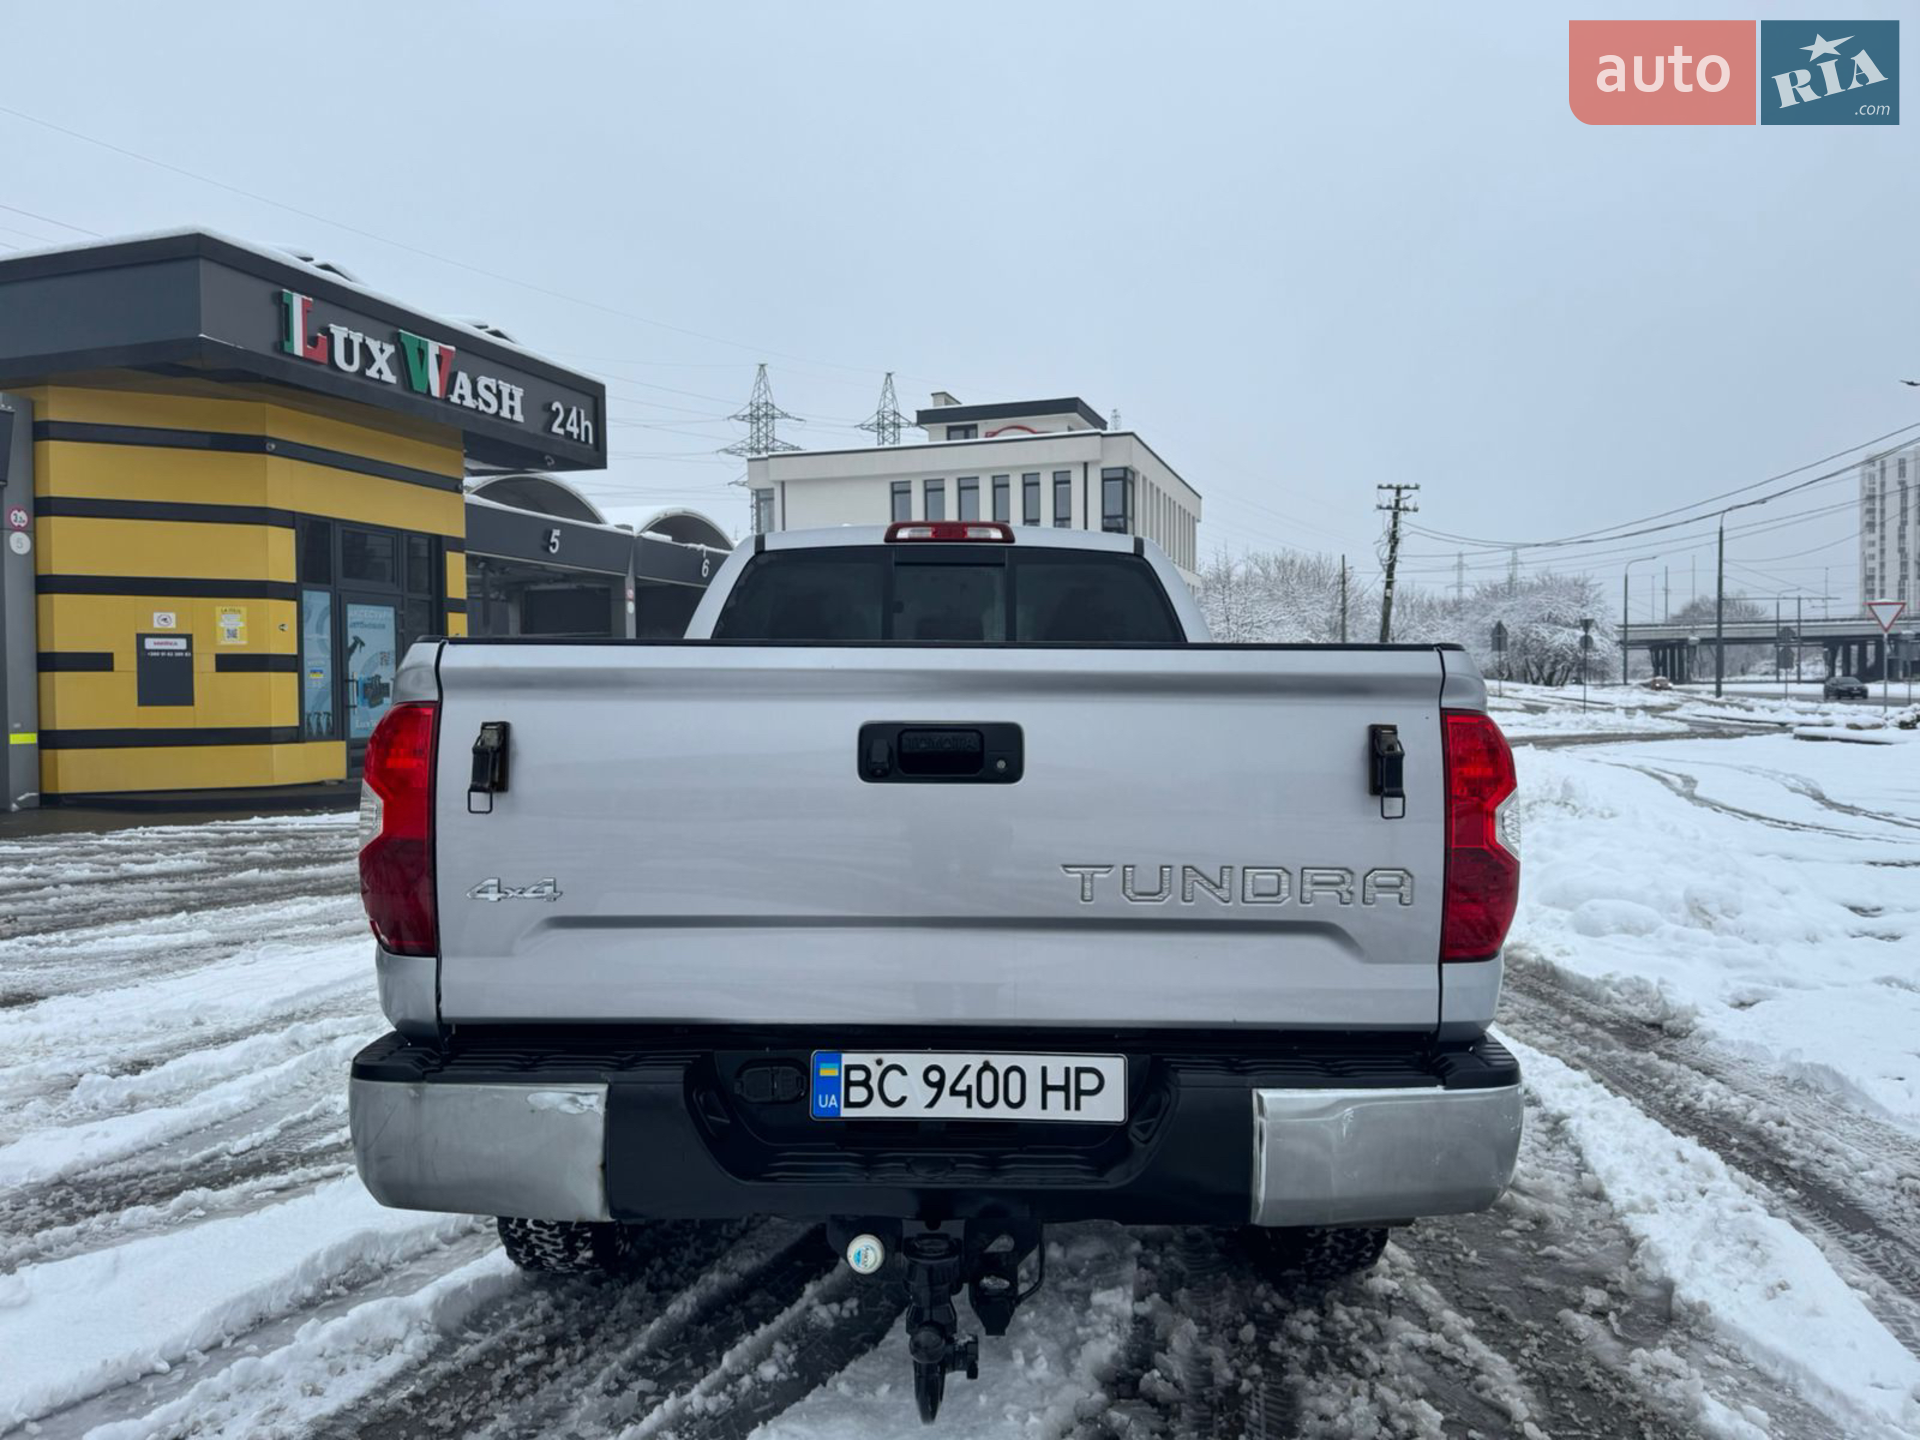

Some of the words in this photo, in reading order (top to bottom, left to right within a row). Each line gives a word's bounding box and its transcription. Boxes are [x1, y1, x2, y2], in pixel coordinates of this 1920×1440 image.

[551, 401, 594, 444] 24h
[549, 529, 561, 553] 5
[701, 559, 710, 578] 6
[466, 877, 563, 902] 4x4
[1060, 864, 1414, 907] TUNDRA
[843, 1063, 909, 1109] BC
[922, 1063, 1027, 1109] 9400
[1041, 1065, 1105, 1111] HP
[818, 1094, 838, 1108] UA
